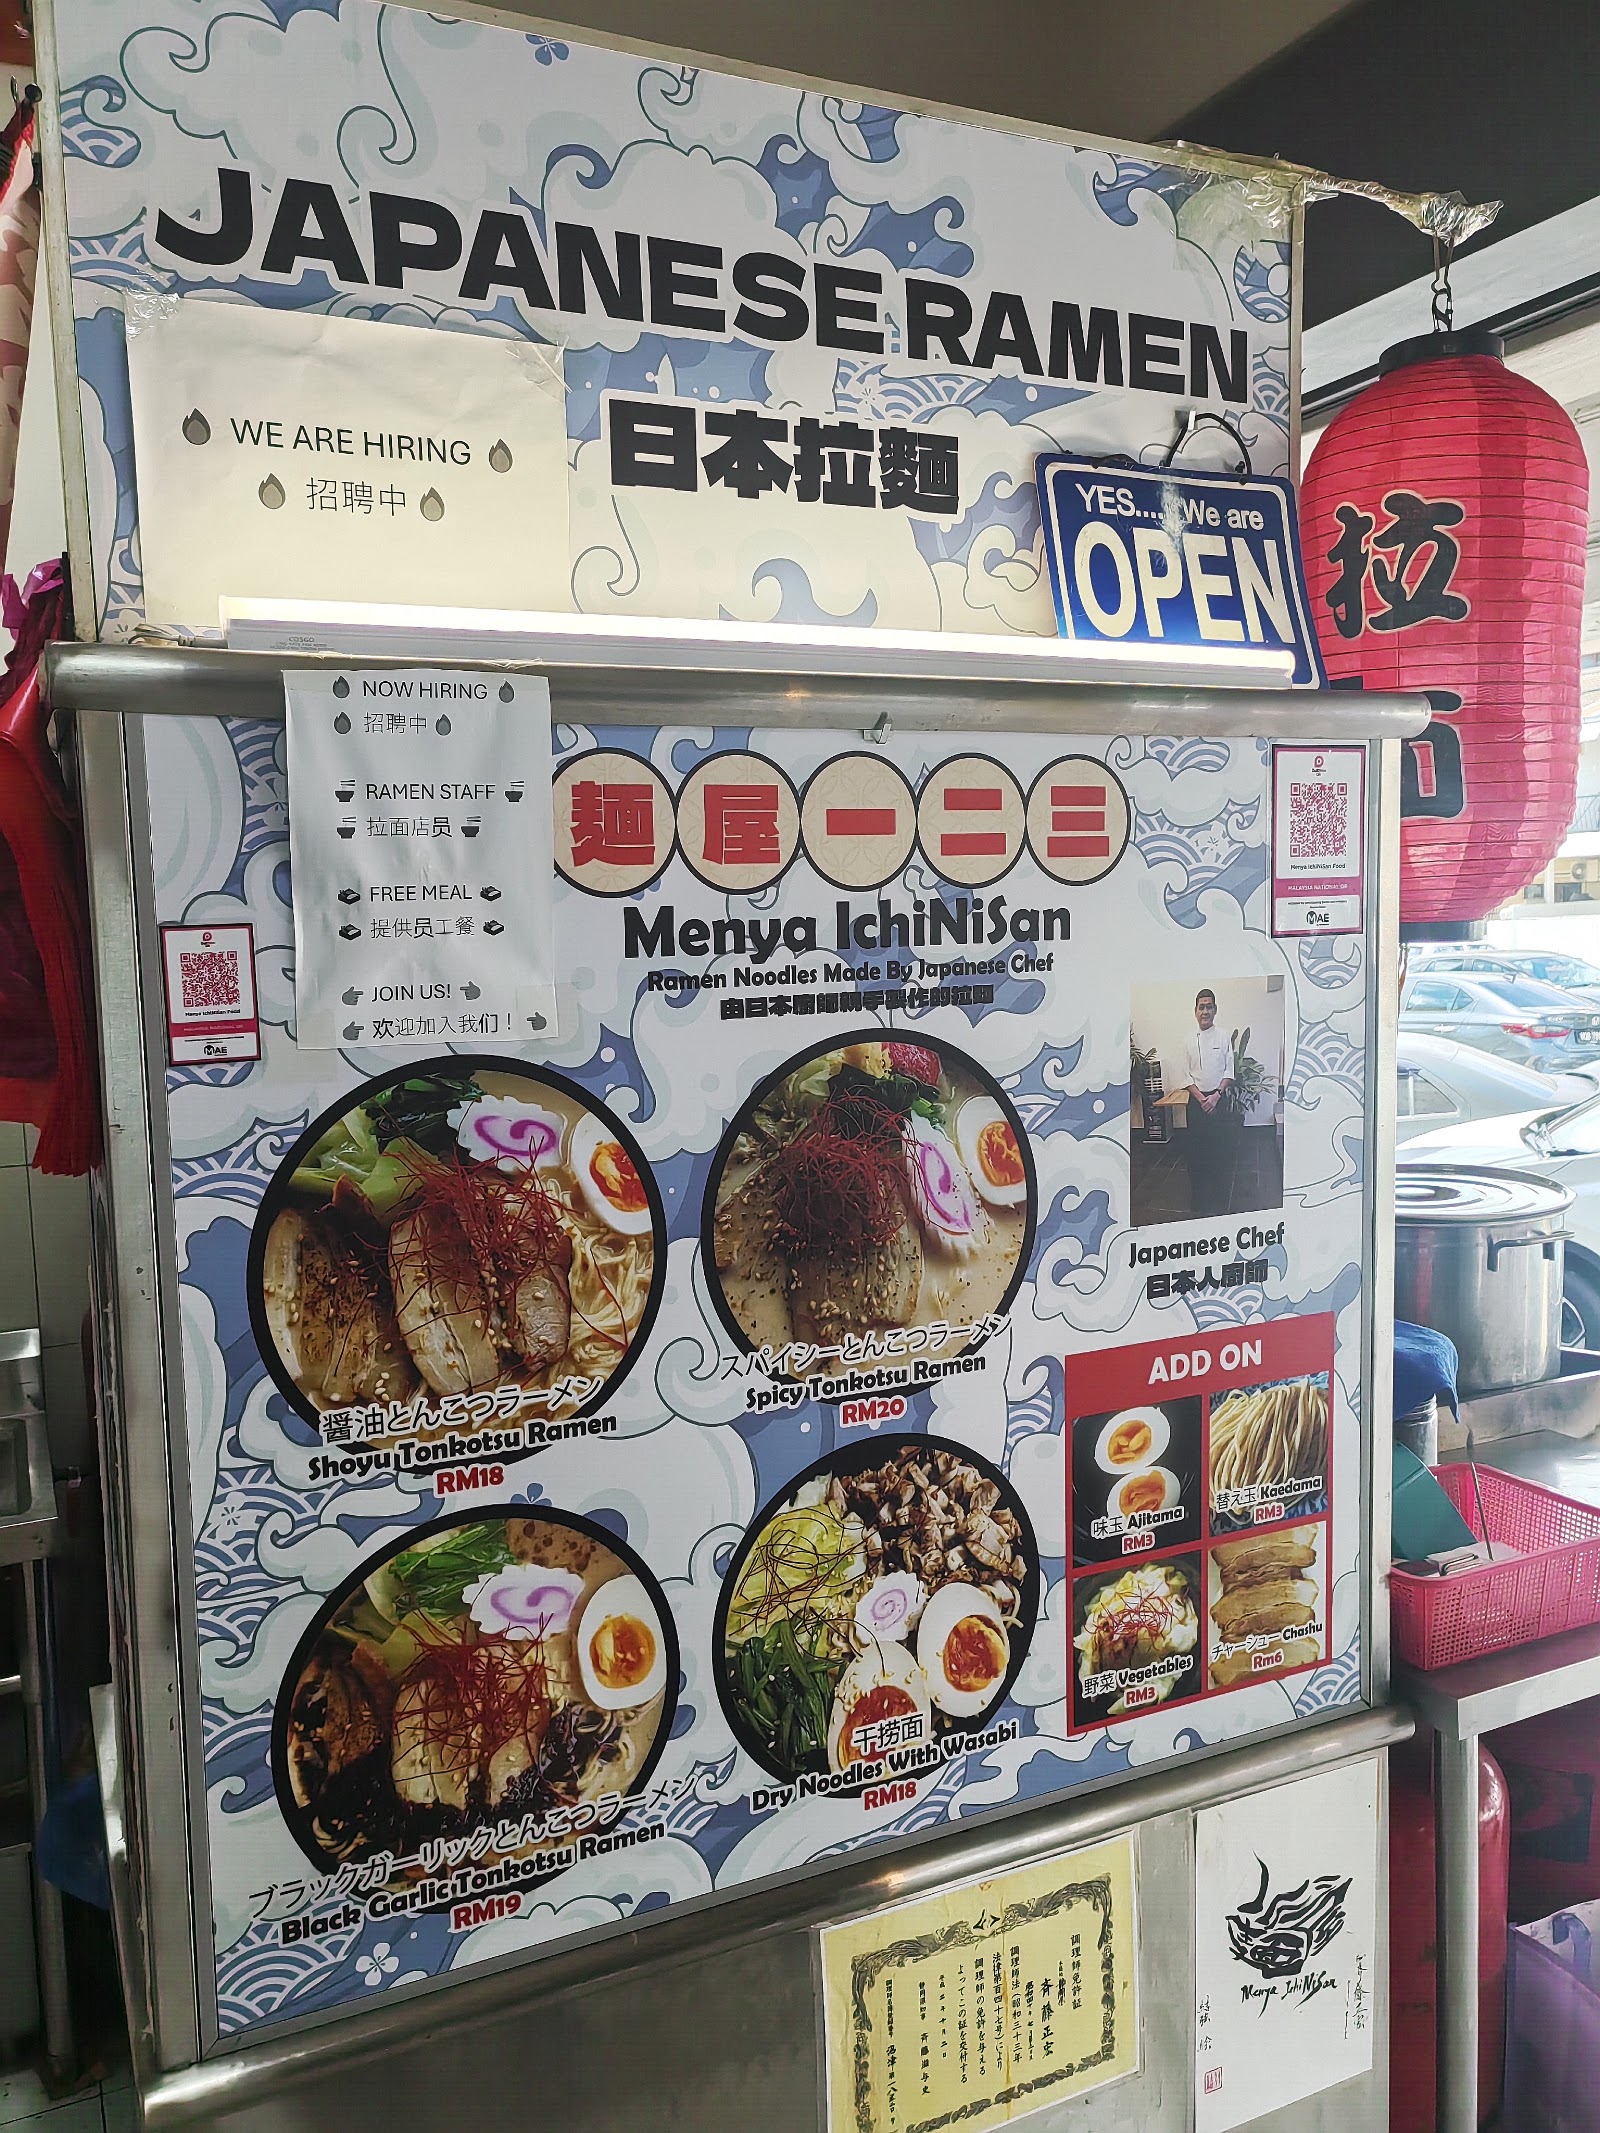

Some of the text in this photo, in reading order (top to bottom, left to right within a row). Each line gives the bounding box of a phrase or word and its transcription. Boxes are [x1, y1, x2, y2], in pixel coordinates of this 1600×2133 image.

[155, 167, 1248, 404] JAPANESE RAMEN
[230, 418, 471, 466] WE ARE HIRING
[609, 399, 959, 514] 日本拉麵
[306, 477, 408, 517] 招聘中
[1181, 497, 1220, 527] We
[1227, 508, 1264, 530] are
[1074, 521, 1296, 644] OPEN
[363, 680, 488, 700] NOW HIRING
[364, 712, 427, 734] 招聘中
[366, 784, 496, 800] RAMEN STAFF
[366, 816, 453, 838] 拉面店员
[370, 884, 472, 902] FREE MEAL
[370, 916, 475, 939] 提供员工餐
[623, 895, 1071, 963] Menya IchiNiSan
[647, 953, 1053, 992] Ramen Noodles Made By Japanese Chef
[372, 983, 451, 1002] JOIN US!
[1129, 1222, 1285, 1268] Japanese Chef
[721, 1313, 1012, 1381] スパイシーとんこつラーメン
[1147, 1339, 1262, 1385] ADD ON
[746, 1356, 986, 1410] Spicy Tonkotsu Ramen
[322, 1376, 601, 1444] 醤油とんこつラーメン
[842, 1399, 904, 1425] RM20
[308, 1415, 617, 1481] Shoyu Tonkotsu Ramen
[436, 1466, 504, 1494] RM18
[1216, 1479, 1321, 1510] 替え玉 Kaedama
[1093, 1508, 1183, 1537] 味玉 Ajitama
[1255, 1505, 1283, 1521] RM3
[1124, 1534, 1153, 1551] RM3
[1211, 1622, 1323, 1660] チャーシュー Chashu
[1084, 1656, 1192, 1696] 野菜 Vegetables
[1253, 1651, 1283, 1670] Rm6
[1126, 1687, 1155, 1705] RM3
[854, 1713, 925, 1755] 干捞面
[752, 1721, 1018, 1812] Dry Noodles With Wasabi
[863, 1781, 917, 1811] RM18
[249, 1774, 698, 1919] ブラックガーリックとんこつラーメン
[279, 1822, 665, 1944] Black Garlic Tonkotsu Ramen
[452, 1894, 522, 1930] RM19
